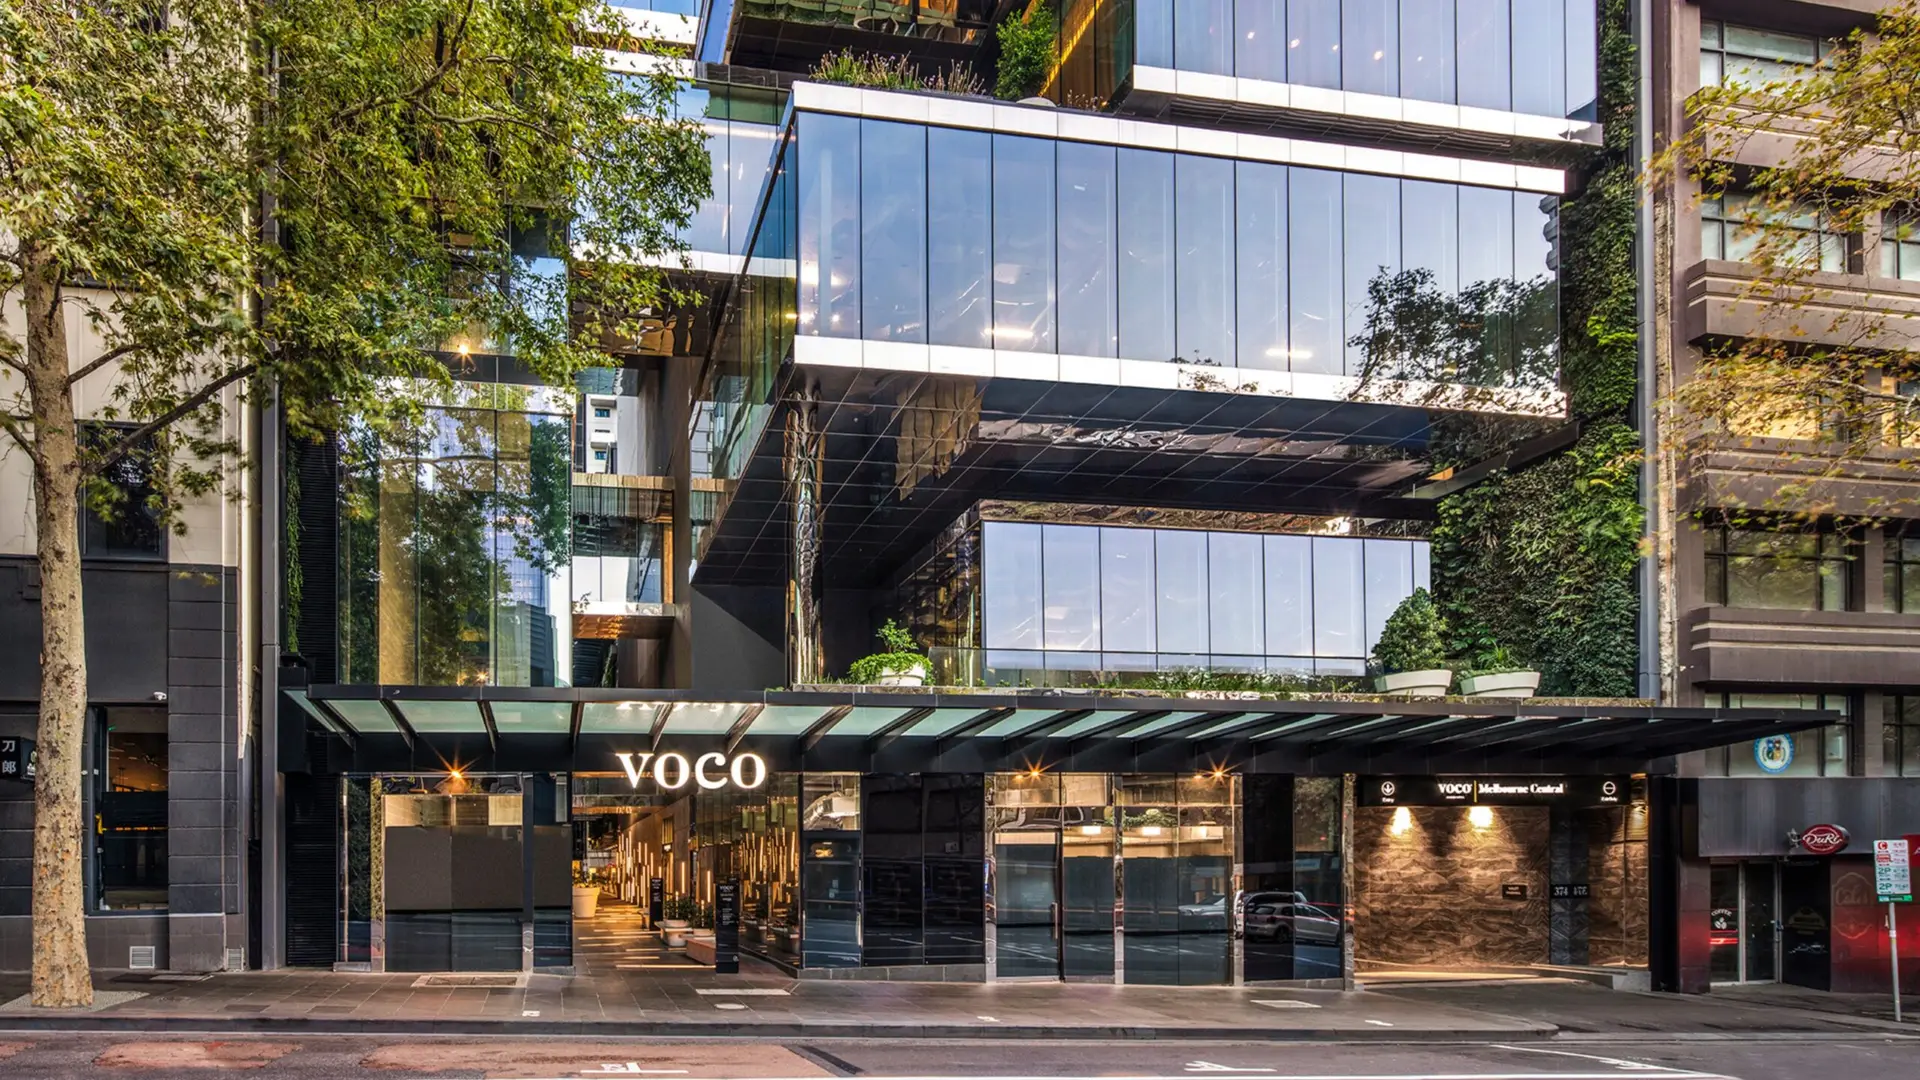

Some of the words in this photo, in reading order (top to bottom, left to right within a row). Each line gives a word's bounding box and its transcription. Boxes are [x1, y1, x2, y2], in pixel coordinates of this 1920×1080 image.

[1478, 783, 1529, 794] Melbourne
[1530, 783, 1564, 794] Central
[1711, 908, 1733, 917] COFFEE
